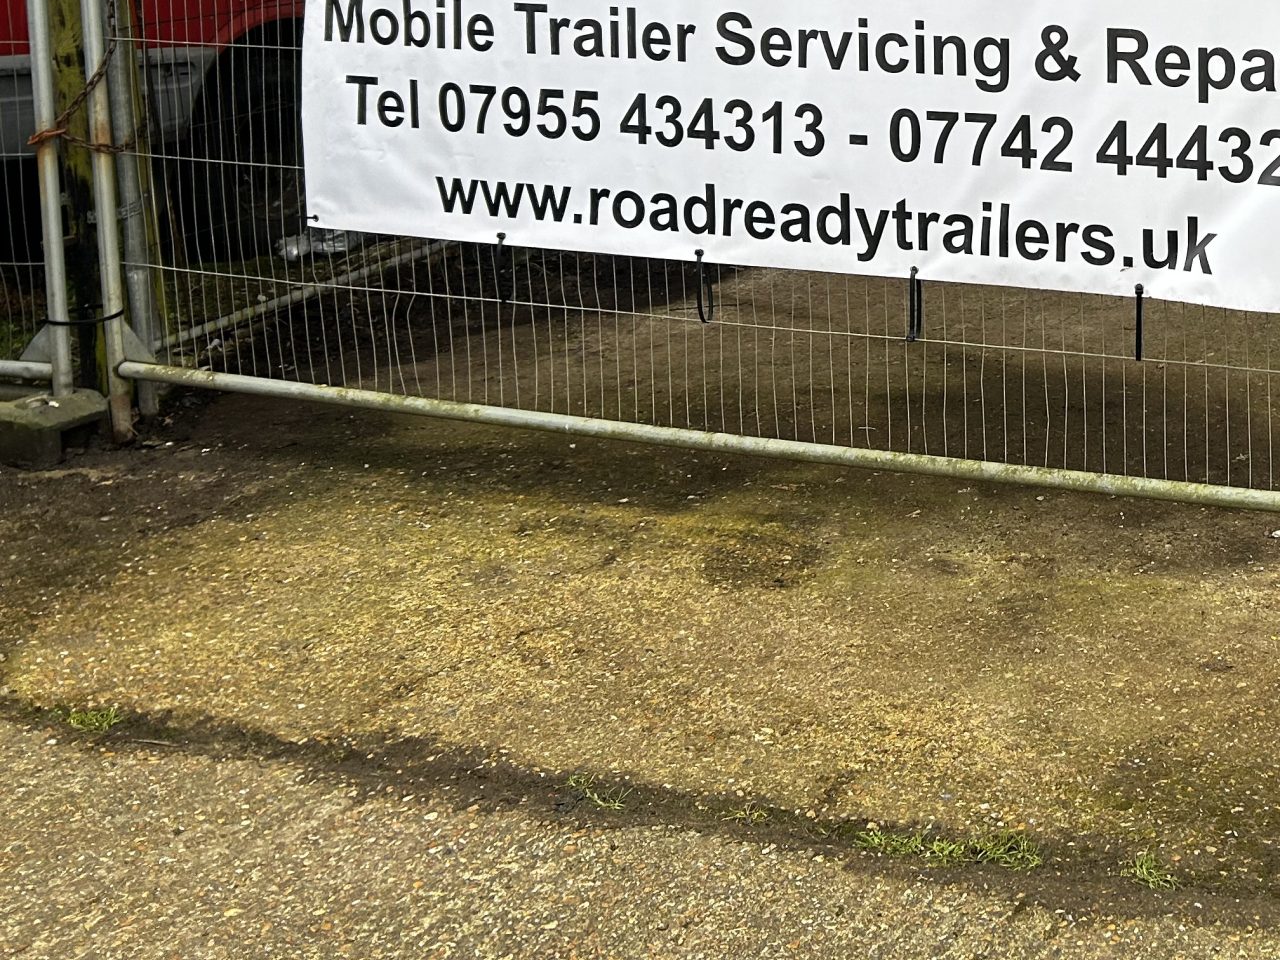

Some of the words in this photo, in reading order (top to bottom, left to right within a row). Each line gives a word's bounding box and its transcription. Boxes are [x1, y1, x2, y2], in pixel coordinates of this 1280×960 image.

[513, 2, 697, 63] Trailer
[715, 11, 1010, 93] Servicing
[1034, 24, 1082, 83] &
[345, 75, 420, 129] Tel
[438, 82, 601, 142] 07955
[619, 92, 825, 157] 434313
[889, 108, 1074, 173] 07742
[435, 176, 1217, 275] www.roadreadytrailers.uk
